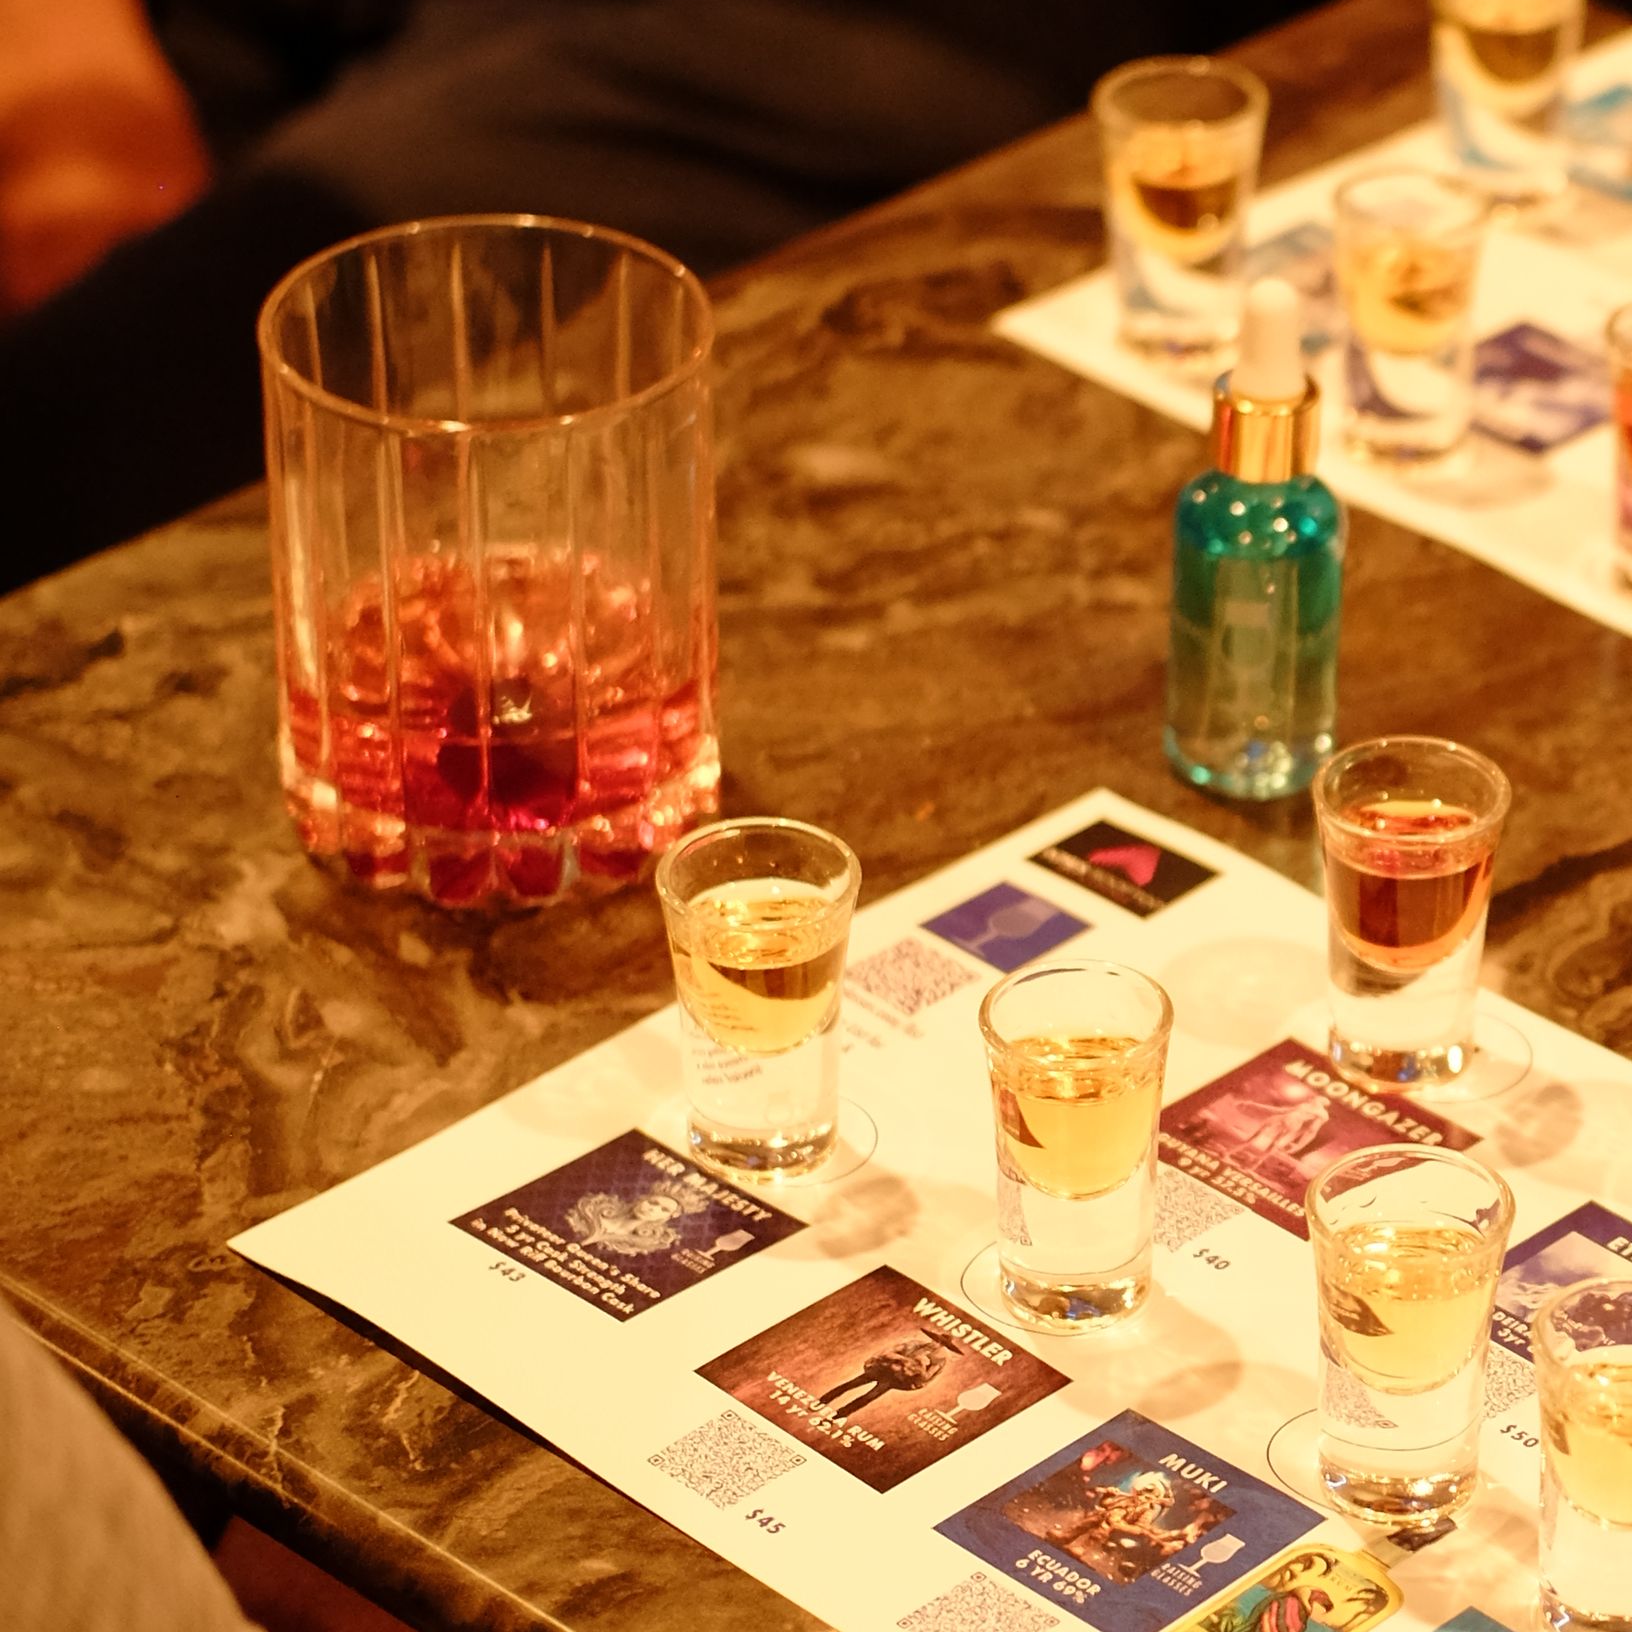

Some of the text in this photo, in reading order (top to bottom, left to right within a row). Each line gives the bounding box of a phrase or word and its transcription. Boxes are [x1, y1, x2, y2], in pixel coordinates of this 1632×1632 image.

[1284, 1060, 1443, 1146] MOONGAZER
[643, 1148, 772, 1221] HER MAJESTY
[1222, 1166, 1306, 1217] VERSAILLES
[488, 1261, 526, 1282] $43
[504, 1207, 661, 1298] Privateer Queen's Share
[536, 1240, 568, 1262] Cask
[569, 1259, 626, 1295] Strength
[1193, 1248, 1231, 1270] $40
[544, 1259, 600, 1294] Bourbon
[601, 1291, 634, 1314] Cask
[913, 1297, 1013, 1366] WHISTLER
[767, 1371, 886, 1452] VENEZUELA RUM
[769, 1390, 791, 1405] 14
[785, 1404, 809, 1418] yr
[918, 1408, 958, 1435] RAISING
[907, 1413, 950, 1441] GLASSES
[1500, 1423, 1540, 1449] $50
[1158, 1453, 1228, 1493] MUKI
[745, 1509, 786, 1534] $45
[1015, 1558, 1089, 1604] 6 YR 69%
[1027, 1549, 1101, 1596] ECUADOR
[1150, 1570, 1194, 1597] GLASSES
[1159, 1563, 1203, 1589] RAISING
